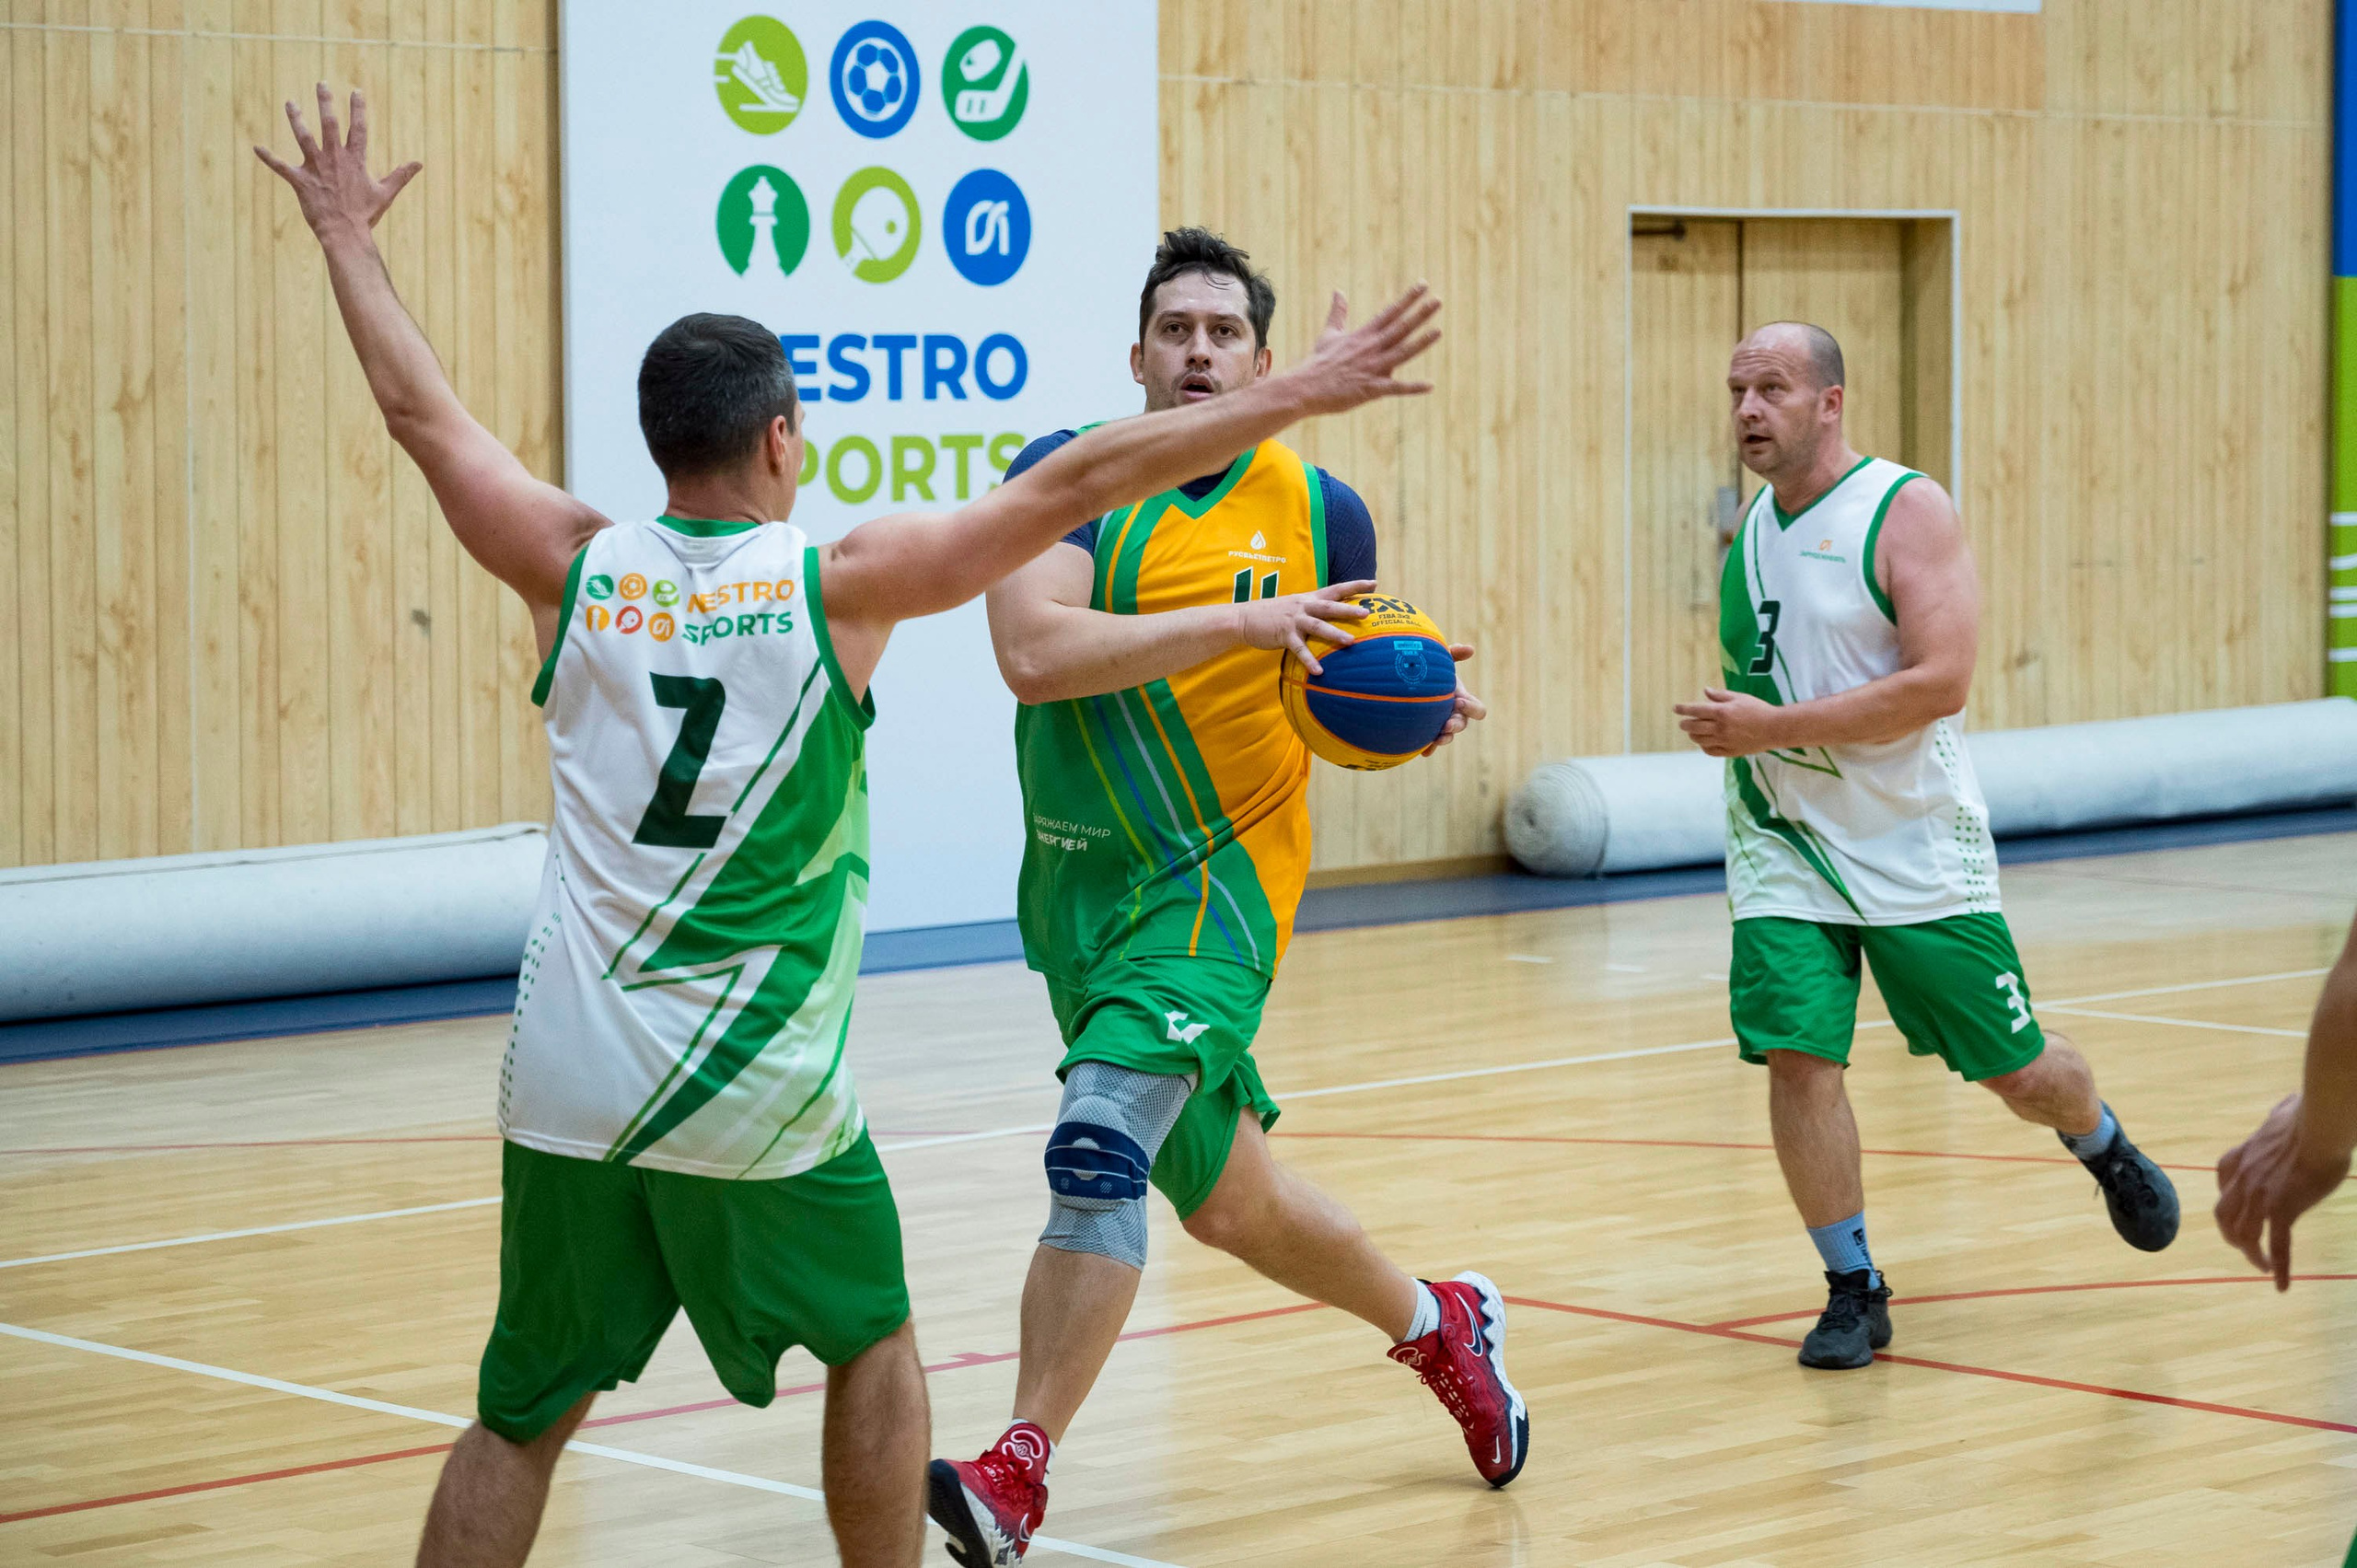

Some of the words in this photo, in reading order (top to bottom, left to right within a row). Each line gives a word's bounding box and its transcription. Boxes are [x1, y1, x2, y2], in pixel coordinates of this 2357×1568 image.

[780, 332, 1028, 403] ESTRO
[796, 433, 1026, 505] ORTS
[686, 579, 795, 614] NESTRO
[681, 611, 794, 646] SPORTS
[1371, 618, 1405, 627] OFFICIAL
[1747, 599, 1782, 677] 3
[1033, 812, 1078, 834] АРЯЖАЕМ
[1080, 824, 1111, 839] МИР
[1037, 829, 1088, 852] НЕРГИЕЙ
[1995, 970, 2031, 1034] 3
